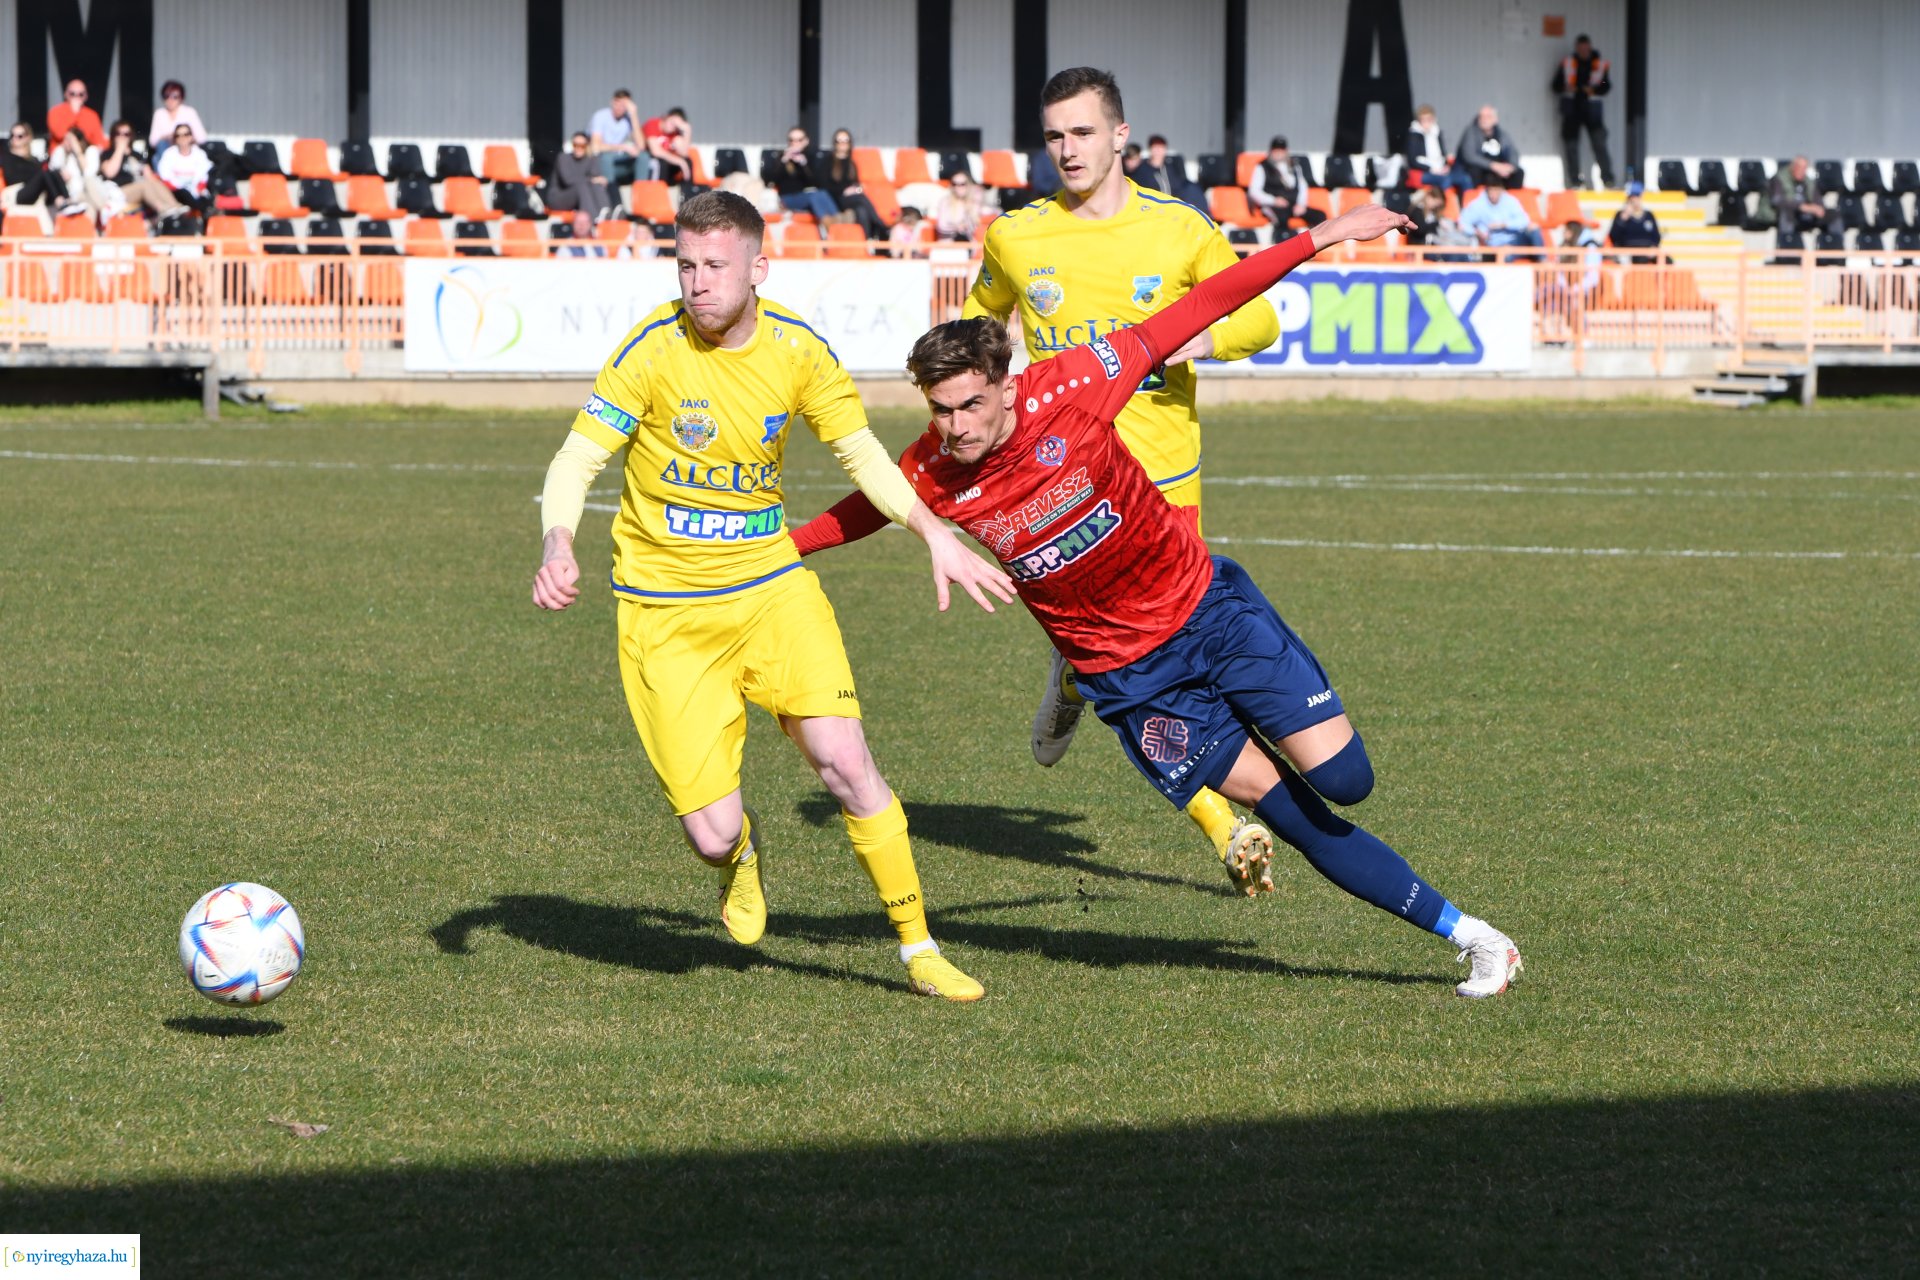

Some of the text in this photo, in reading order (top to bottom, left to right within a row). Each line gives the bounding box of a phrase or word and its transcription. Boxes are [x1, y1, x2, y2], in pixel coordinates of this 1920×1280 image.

[1029, 266, 1055, 276] JAKO
[680, 399, 709, 409] JAKO
[955, 486, 981, 504] JAKO
[1057, 504, 1067, 517] THE
[1080, 488, 1092, 502] WAY
[837, 689, 856, 699] JAK
[1307, 689, 1331, 707] JAKO
[884, 893, 917, 908] JAKO
[1401, 882, 1420, 914] JAKO
